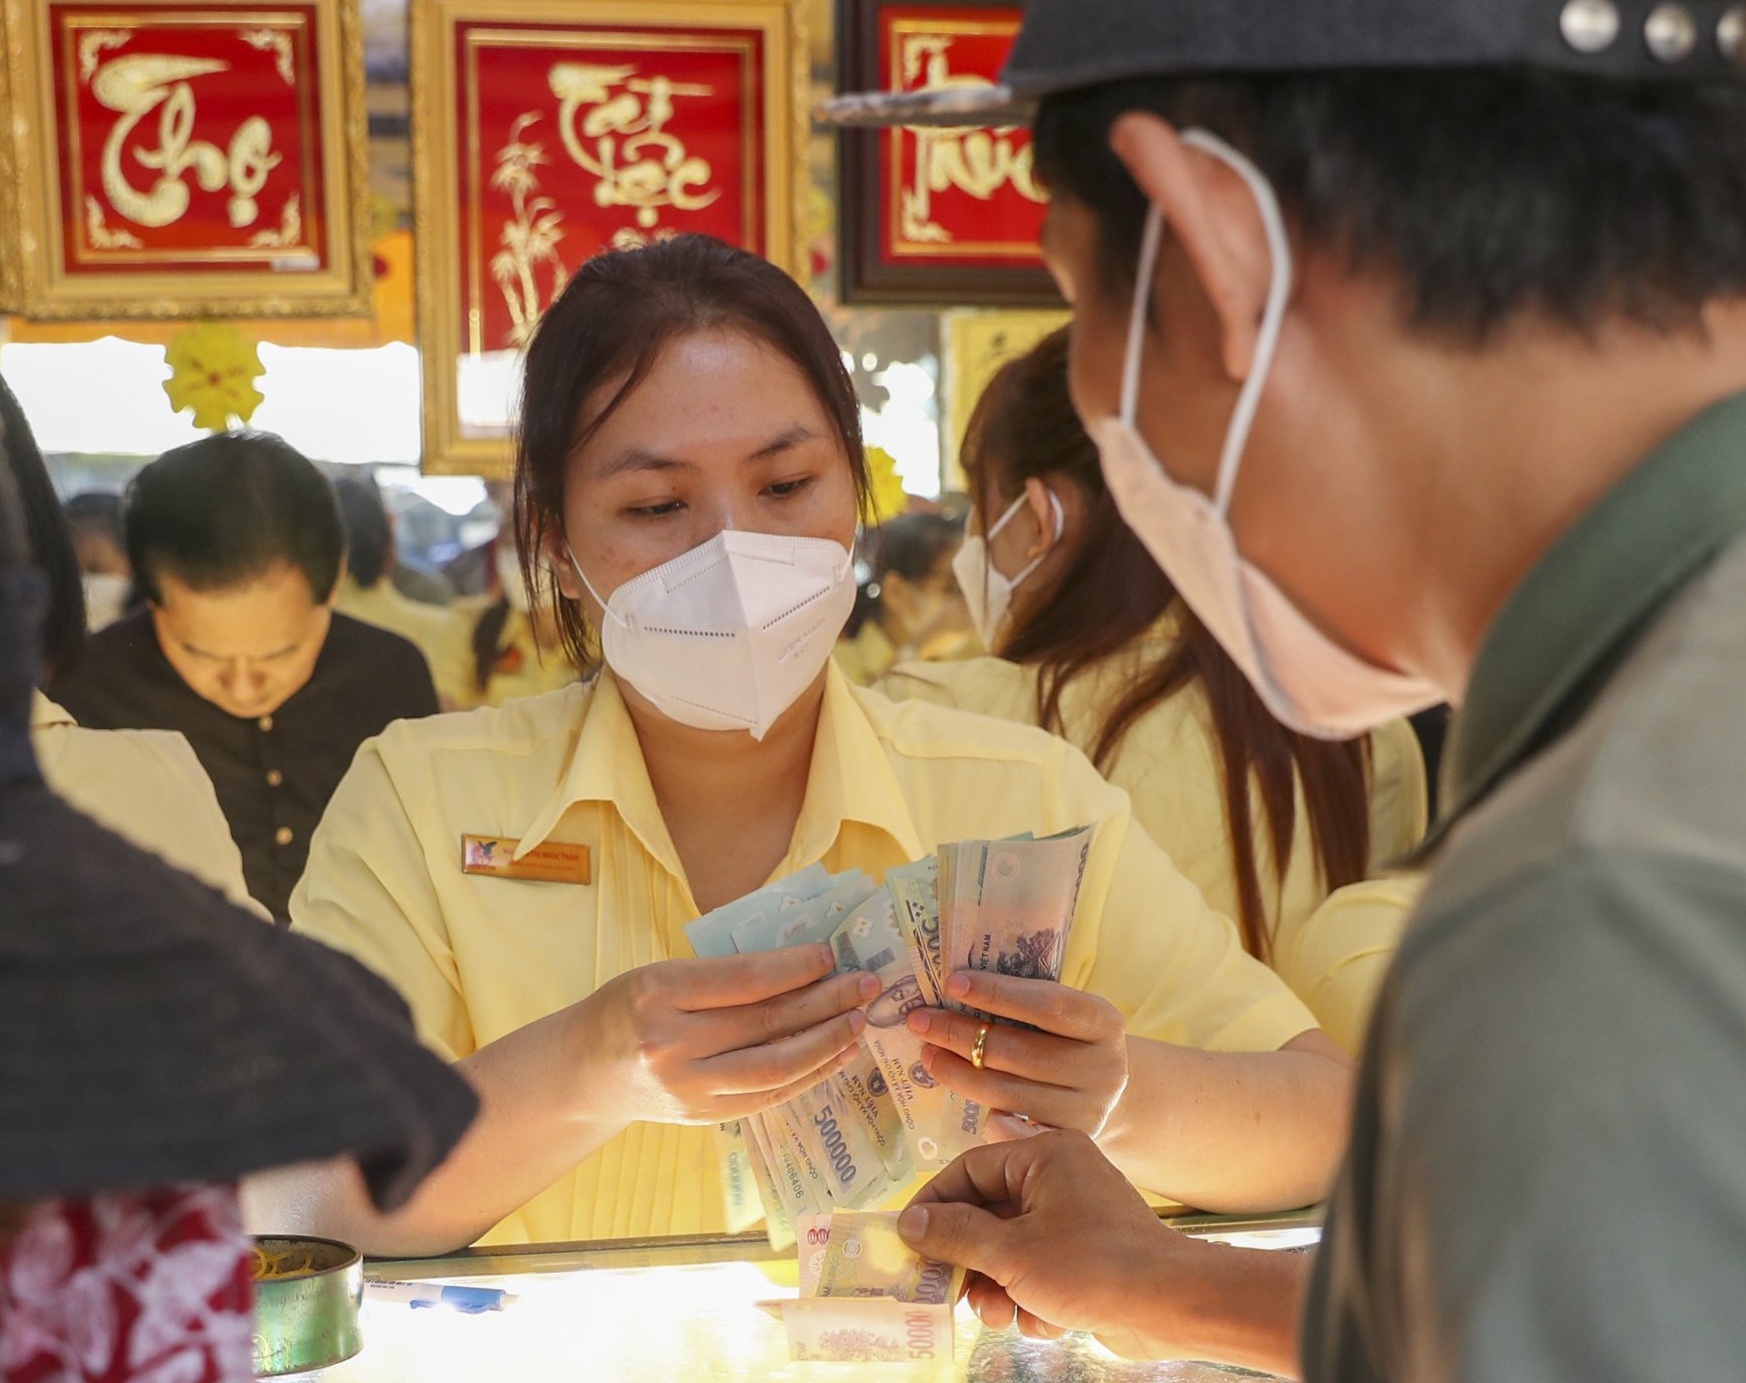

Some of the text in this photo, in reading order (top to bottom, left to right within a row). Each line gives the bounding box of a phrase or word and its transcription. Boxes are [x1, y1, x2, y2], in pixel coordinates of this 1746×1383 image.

[982, 934, 991, 951] NAM
[850, 1074, 880, 1118] VIỆT NAM
[892, 1057, 915, 1099] VIỆT NAM
[814, 1104, 858, 1183] 500000
